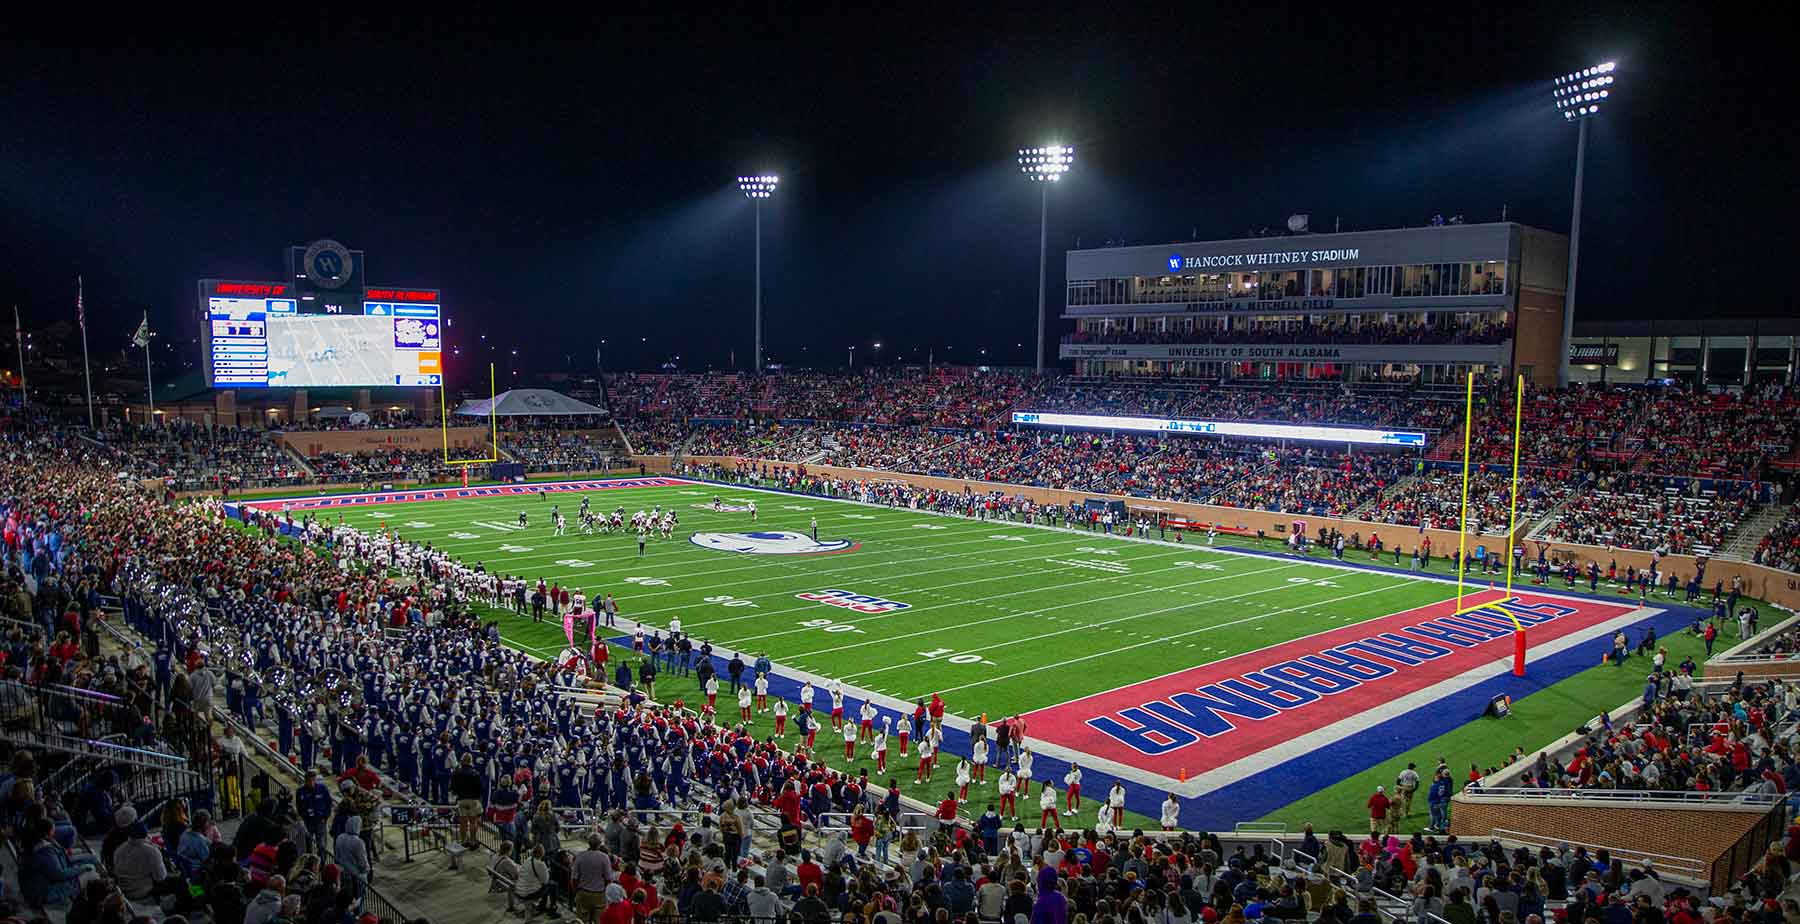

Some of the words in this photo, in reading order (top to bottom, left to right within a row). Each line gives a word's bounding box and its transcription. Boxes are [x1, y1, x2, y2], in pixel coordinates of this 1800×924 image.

[1185, 255, 1242, 268] HANCOCK
[1247, 252, 1309, 266] WHITNEY
[1311, 249, 1359, 262] STADIUM
[1185, 303, 1233, 313] ABRAHAM
[1248, 300, 1301, 311] MITCHELL
[1303, 299, 1334, 310] FIELD
[1168, 348, 1227, 357] UNIVERSITY
[1232, 348, 1243, 357] OF
[1249, 348, 1284, 357] SOUTH
[1289, 348, 1340, 357] ALABAMA
[1400, 597, 1578, 648] SOUTH
[918, 648, 982, 664] 10
[1085, 633, 1454, 757] ALABAMA
